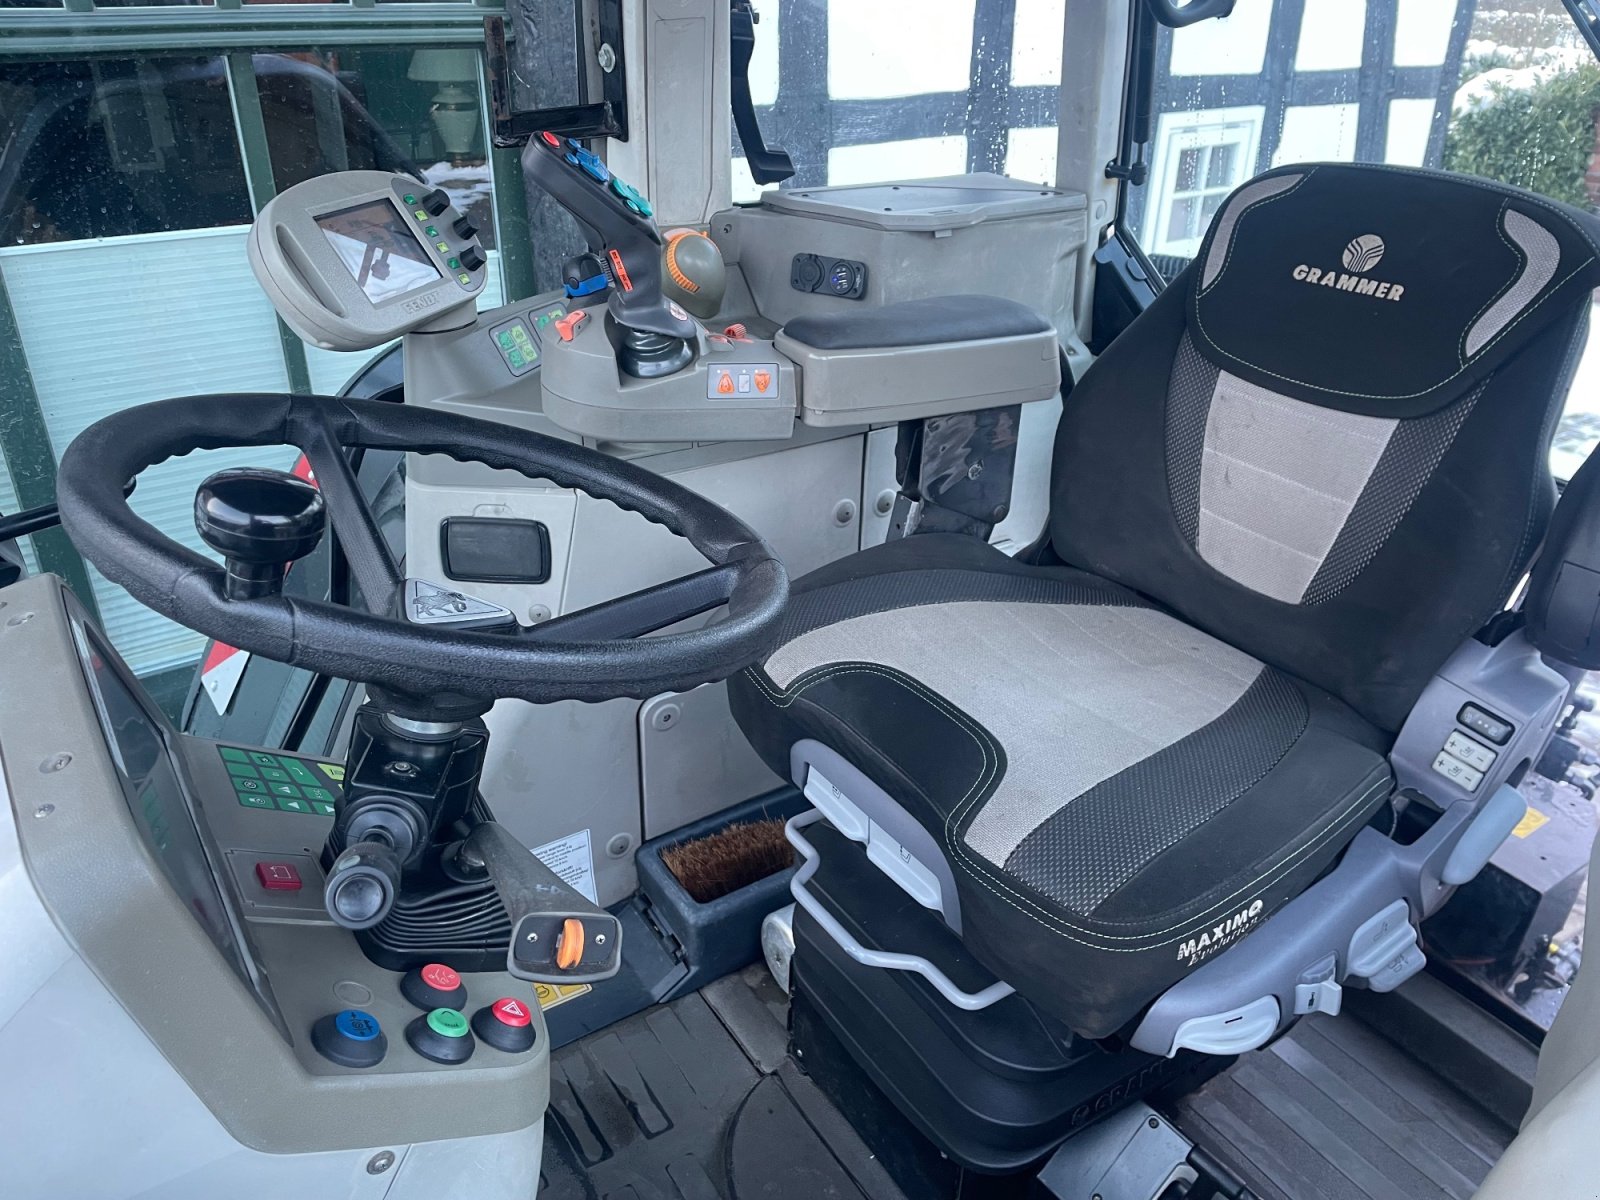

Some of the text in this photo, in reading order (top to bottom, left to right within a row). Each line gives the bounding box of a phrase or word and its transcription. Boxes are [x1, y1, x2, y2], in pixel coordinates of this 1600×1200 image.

[1293, 265, 1404, 301] GRAMMER
[401, 290, 440, 314] FENDT
[1177, 900, 1263, 960] MAXIMO
